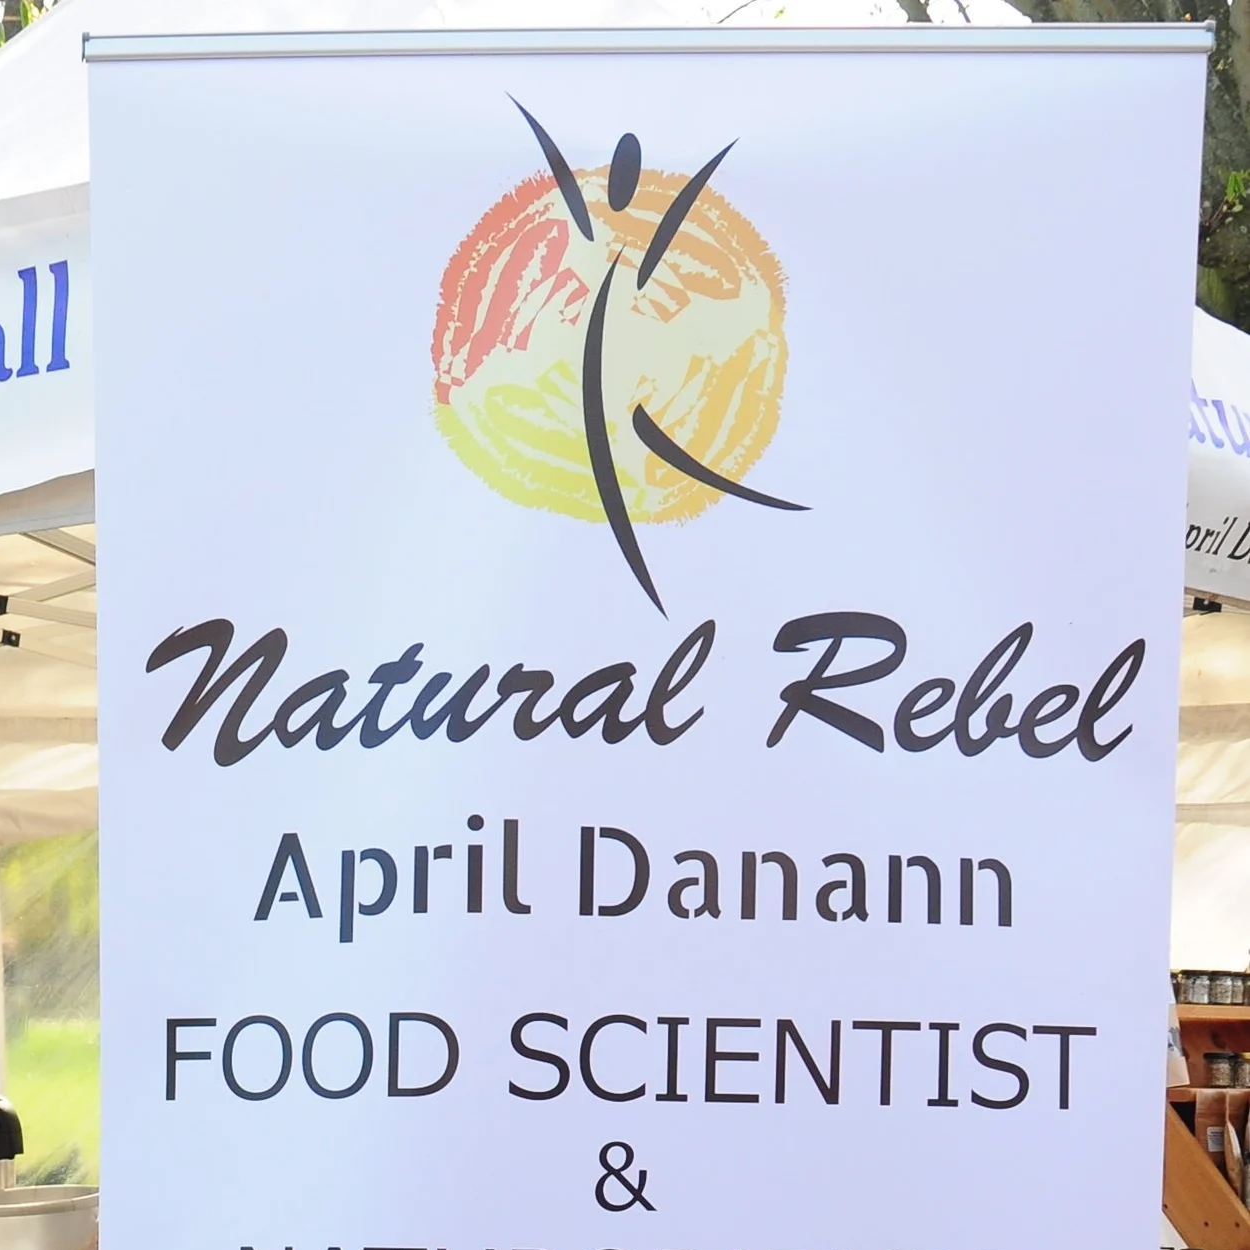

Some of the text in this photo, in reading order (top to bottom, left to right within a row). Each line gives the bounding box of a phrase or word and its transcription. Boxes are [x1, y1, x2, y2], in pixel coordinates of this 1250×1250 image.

[145, 610, 1146, 768] Natural Rebel
[253, 814, 1014, 944] April Danann
[165, 1011, 1098, 1110] FOOD SCIENTIST
[594, 1141, 658, 1213] &
